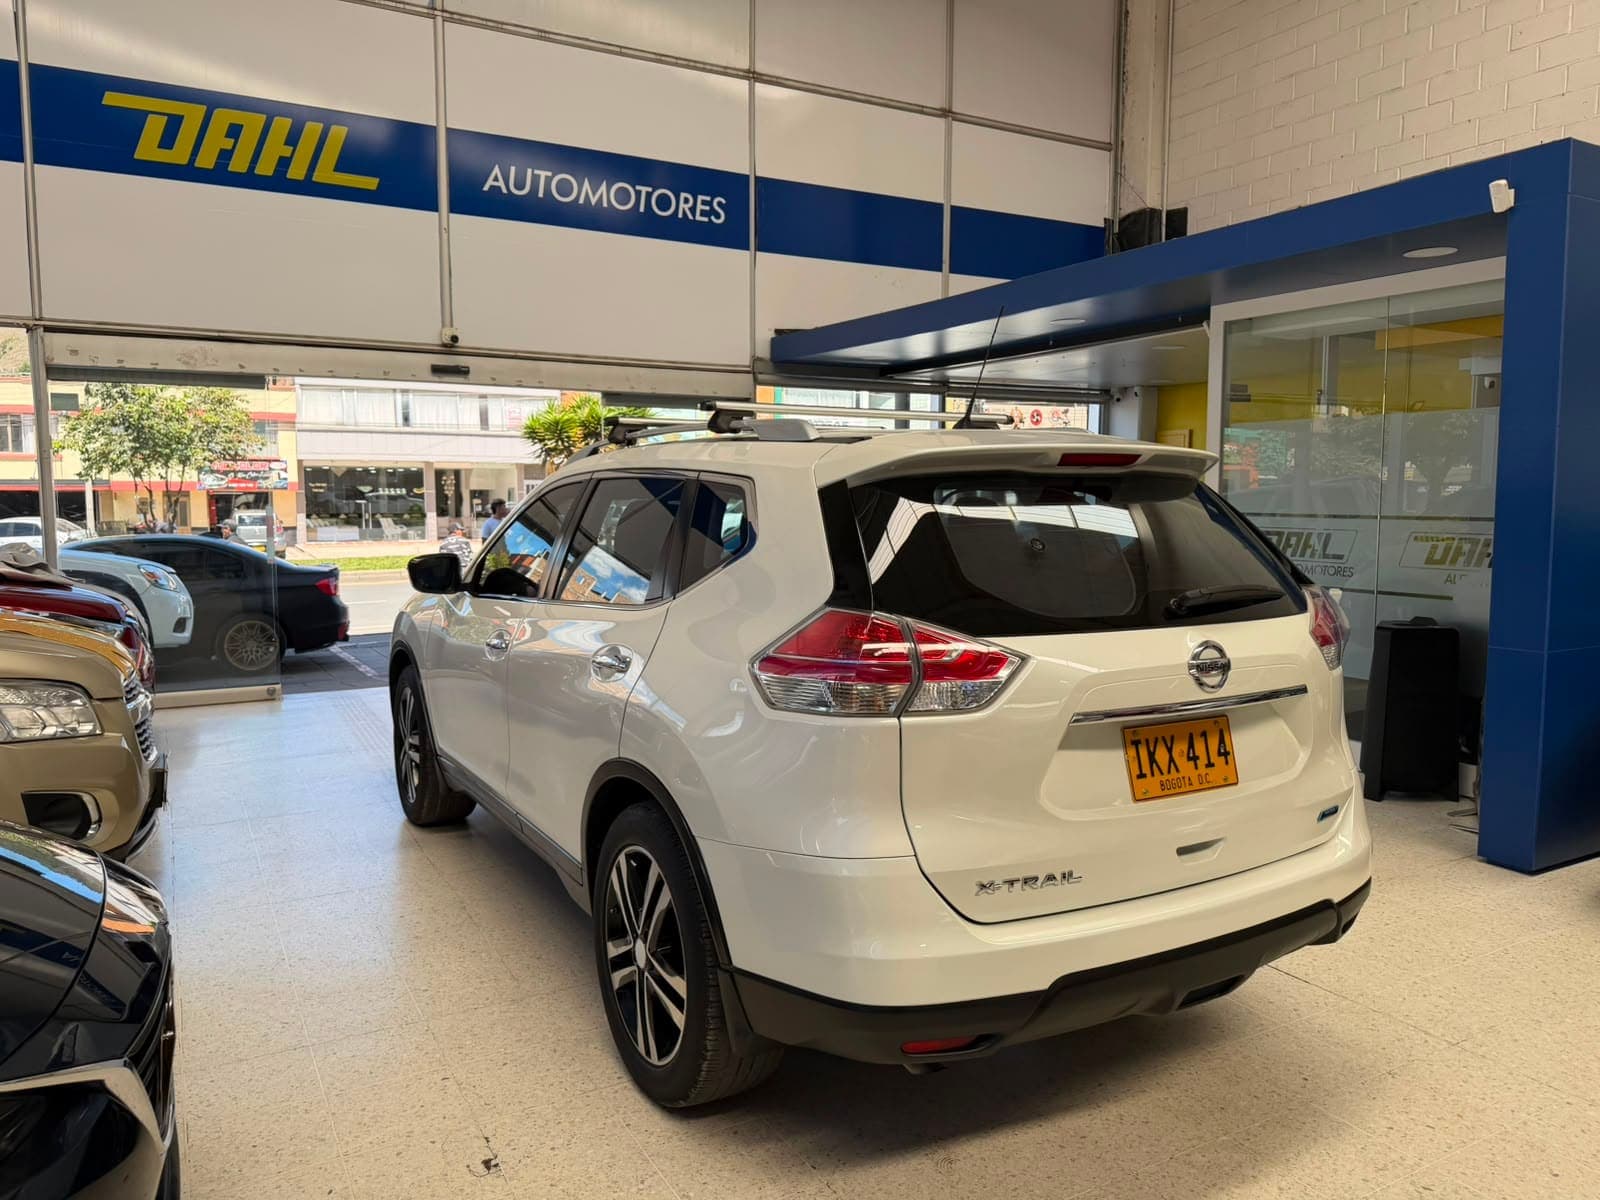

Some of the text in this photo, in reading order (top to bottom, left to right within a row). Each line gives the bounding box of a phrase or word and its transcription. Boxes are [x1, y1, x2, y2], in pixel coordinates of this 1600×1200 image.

[102, 91, 379, 190] DAHL
[482, 164, 727, 225] AUTOMOTORES
[1413, 535, 1493, 568] DAH
[1131, 728, 1230, 779] IKX 414
[1159, 775, 1194, 792] BOGOTA
[975, 870, 1083, 896] X-TRAIL
